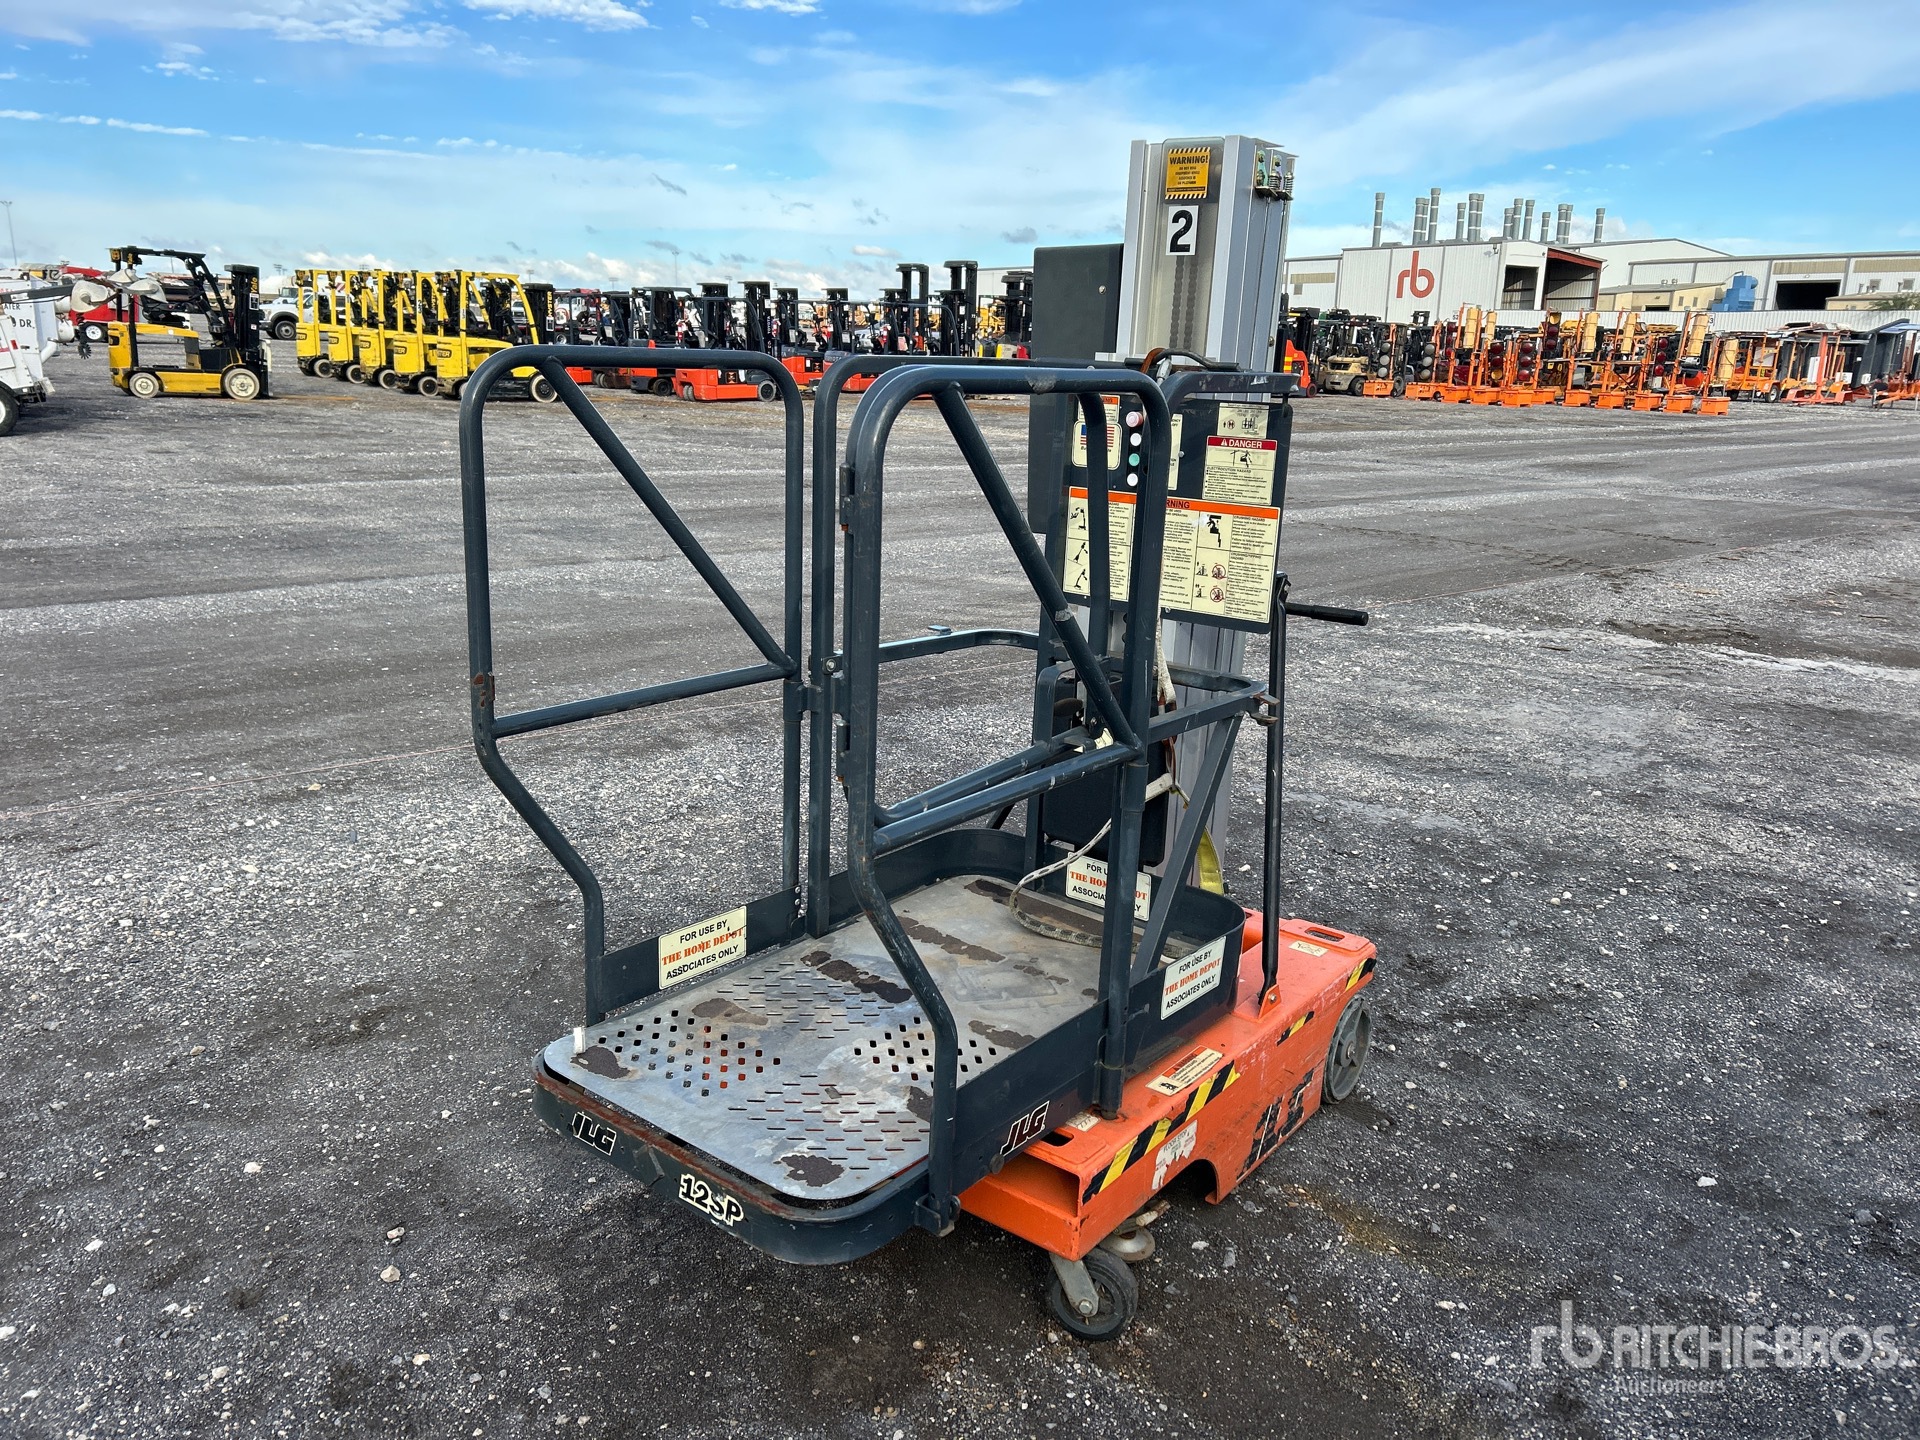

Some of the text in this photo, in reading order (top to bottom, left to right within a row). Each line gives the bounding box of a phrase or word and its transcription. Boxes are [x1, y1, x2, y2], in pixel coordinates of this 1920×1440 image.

[1169, 155, 1208, 165] WARNING!
[1169, 209, 1193, 253] 2
[1396, 250, 1435, 298] rb
[1228, 439, 1263, 449] DANGER
[1166, 499, 1190, 509] RNING
[1070, 871, 1107, 888] THE HOM
[1086, 863, 1102, 874] FOR
[1072, 886, 1107, 901] ASSOCIA
[662, 927, 744, 966] THE HOME DEPOT
[680, 919, 728, 943] FOR USE BY
[666, 944, 739, 980] ASSOCIATES ONLY
[1164, 958, 1222, 996] THE HOME DEPOT
[1178, 949, 1212, 974] FOR USE BY
[1165, 974, 1217, 1010] ASSOCIATES ONLY
[567, 1111, 617, 1157] JLG
[1000, 1100, 1050, 1157] JLG
[679, 1173, 745, 1227] 12SP
